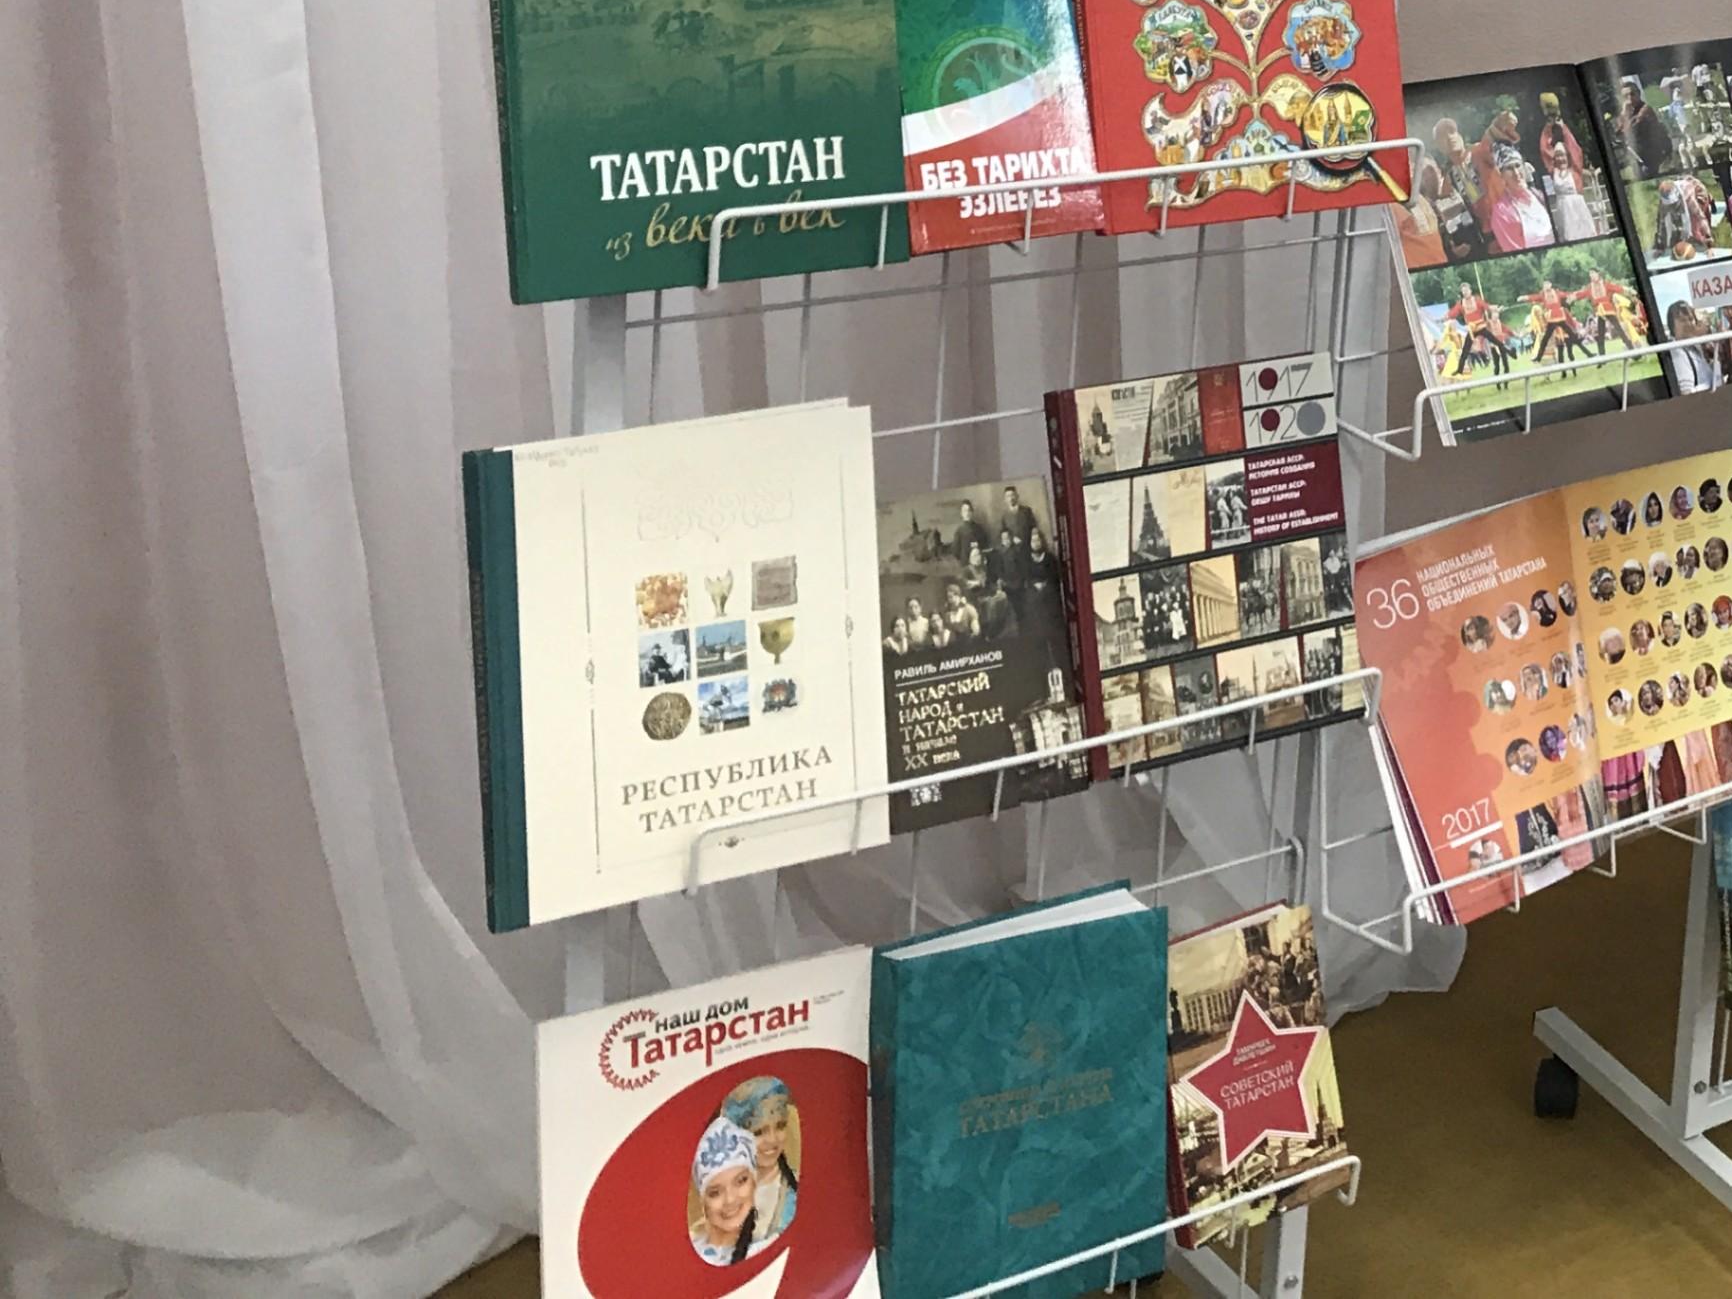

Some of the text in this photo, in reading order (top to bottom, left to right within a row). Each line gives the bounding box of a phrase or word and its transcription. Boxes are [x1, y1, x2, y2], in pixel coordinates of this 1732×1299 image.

[590, 136, 846, 201] ТАТАРСТАН
[920, 146, 1093, 191] БЕЗ ТАРИХТА
[605, 229, 631, 261] из
[1246, 362, 1313, 403] 1917
[1366, 543, 1497, 630] 36 НАЦИОНАЛЬНЫХ
[1420, 557, 1501, 598] ОБЩЕСТВЕННЫХ
[1426, 555, 1548, 613] ОБЪЕДИНЕНИЙ ТАТАРСТАНА
[894, 649, 1004, 680] РАВИЛЬ АМИРХАНОВ
[895, 670, 991, 707] ТАТАРСКИЙ
[898, 699, 953, 725] НАРОД
[898, 704, 1005, 743] ТАТАРСТАН
[620, 743, 833, 806] РЕСПУБЛИКА
[638, 777, 820, 836] ТАТАРСТАН
[1441, 798, 1492, 841] 2017
[622, 999, 810, 1068] Татарстан
[655, 996, 750, 1034] наш дом
[1220, 1060, 1295, 1098] СОВЕТСКИЙ
[1224, 1075, 1295, 1111] ТАТАРСТАН
